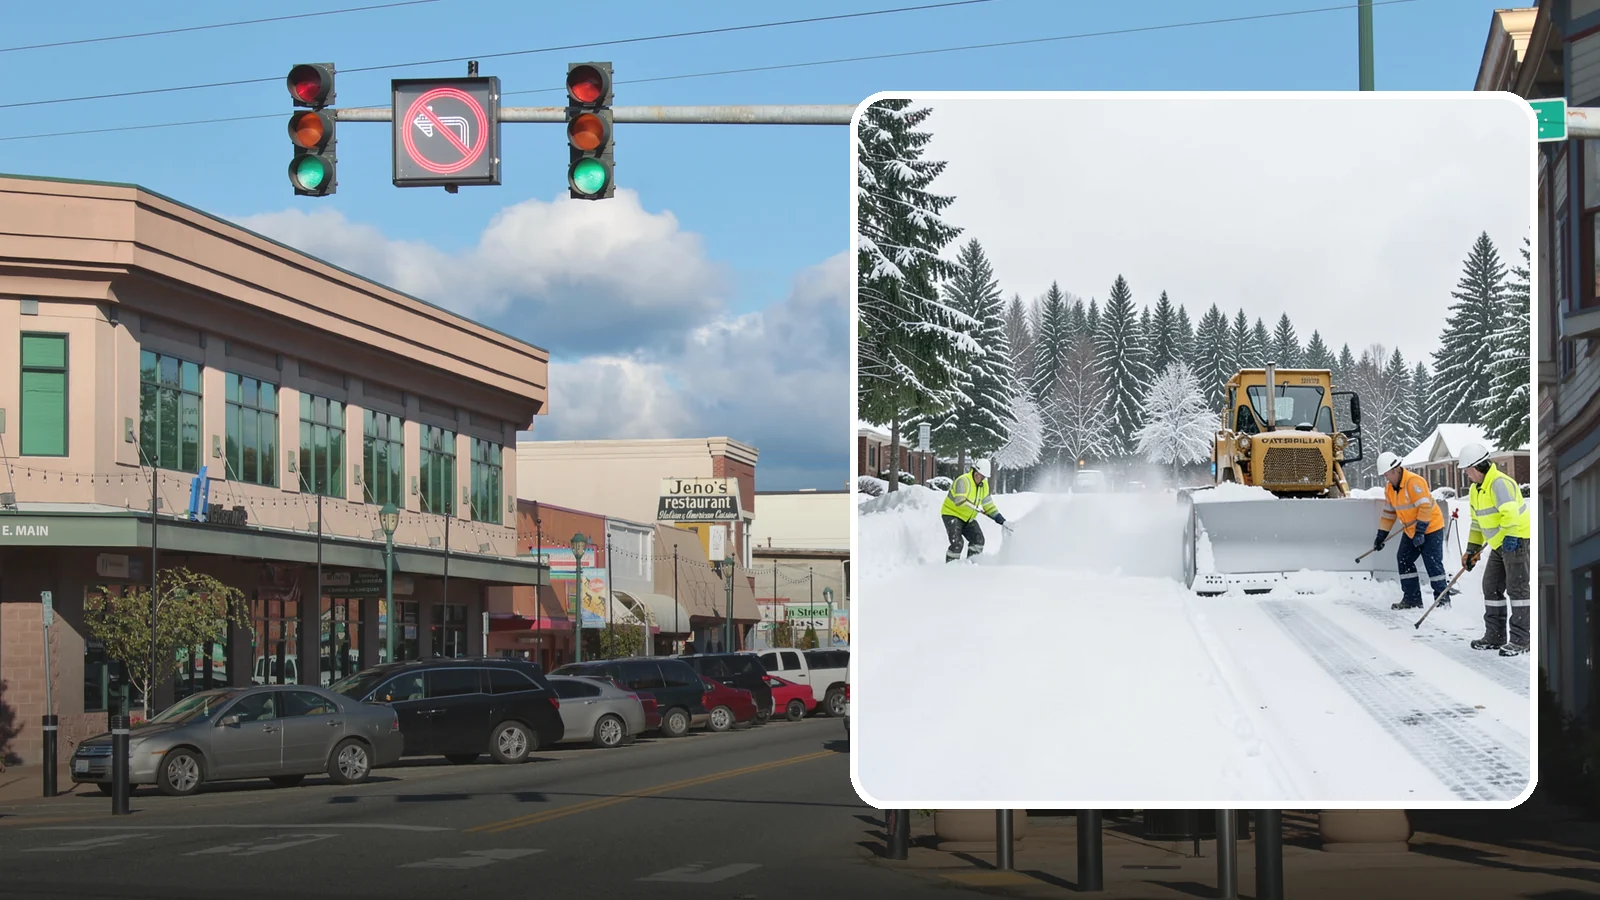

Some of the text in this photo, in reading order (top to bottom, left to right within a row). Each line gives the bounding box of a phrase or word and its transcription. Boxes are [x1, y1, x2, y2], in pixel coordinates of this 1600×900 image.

[670, 480, 728, 494] Jeno's
[665, 496, 731, 509] restaurant
[658, 510, 681, 519] Italian
[686, 510, 714, 519] American
[715, 509, 737, 519] Cuisine
[2, 525, 49, 536] E. MAIN
[797, 607, 829, 617] Street
[791, 619, 824, 627] lass
